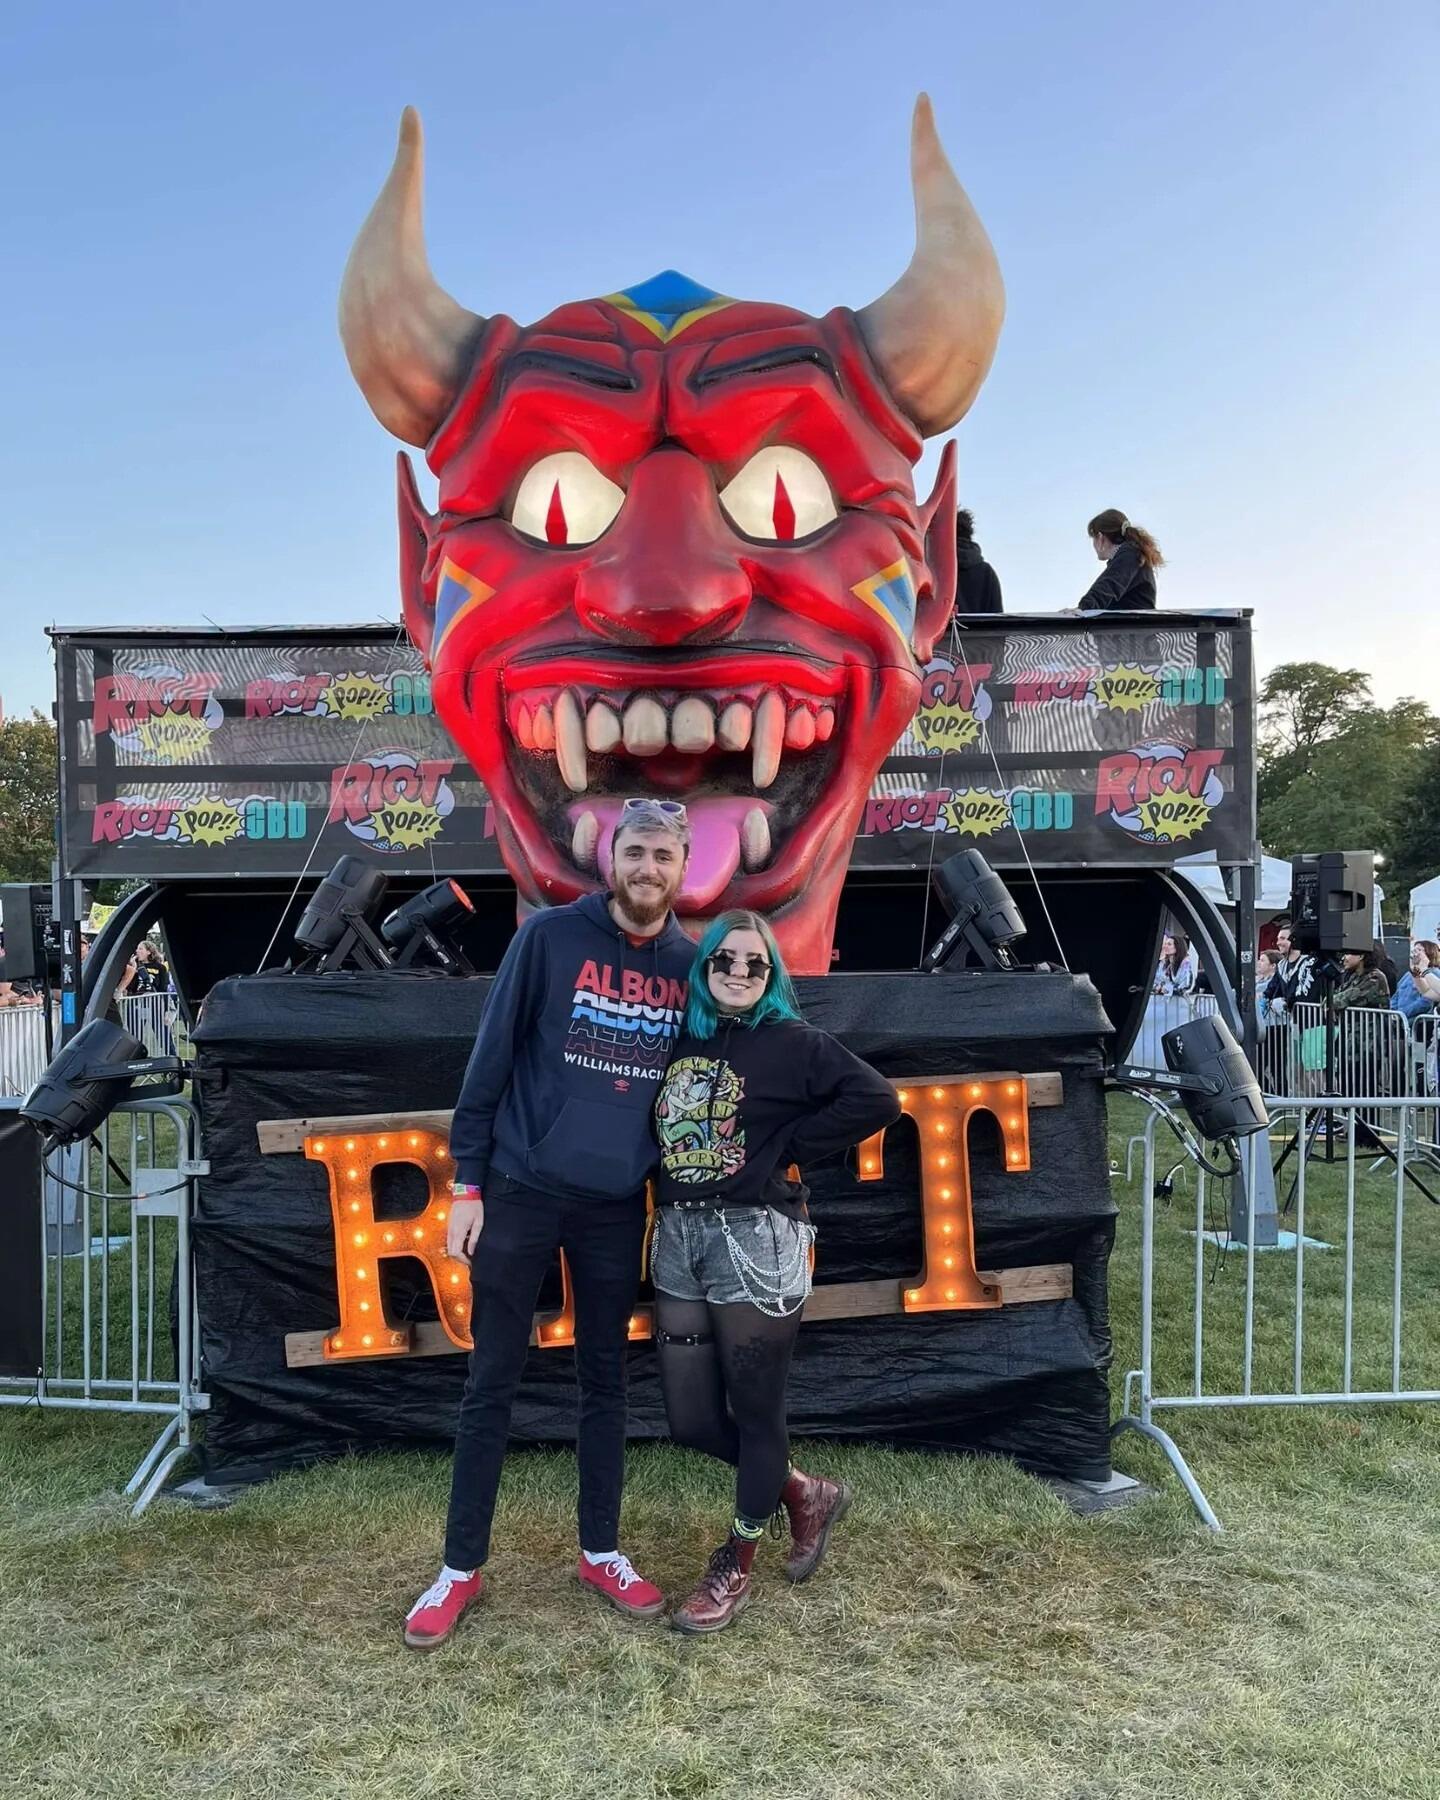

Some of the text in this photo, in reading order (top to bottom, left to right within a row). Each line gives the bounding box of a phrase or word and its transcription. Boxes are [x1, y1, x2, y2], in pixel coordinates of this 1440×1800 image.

[93, 672, 223, 736] RIOT
[245, 674, 432, 720] RIOT POP!! CB
[921, 664, 992, 712] OT
[1014, 666, 1225, 708] RIOT POP!! CBD
[918, 715, 976, 741] POP!!
[327, 759, 455, 825] RIOT
[1095, 749, 1224, 816] RIOT
[92, 799, 307, 844] RIOT POP!! CBD
[381, 810, 439, 836] POP!!
[865, 791, 1073, 835] RIOT POP!! CBD
[1147, 801, 1207, 828] POP!!
[574, 959, 689, 1010] ALBON
